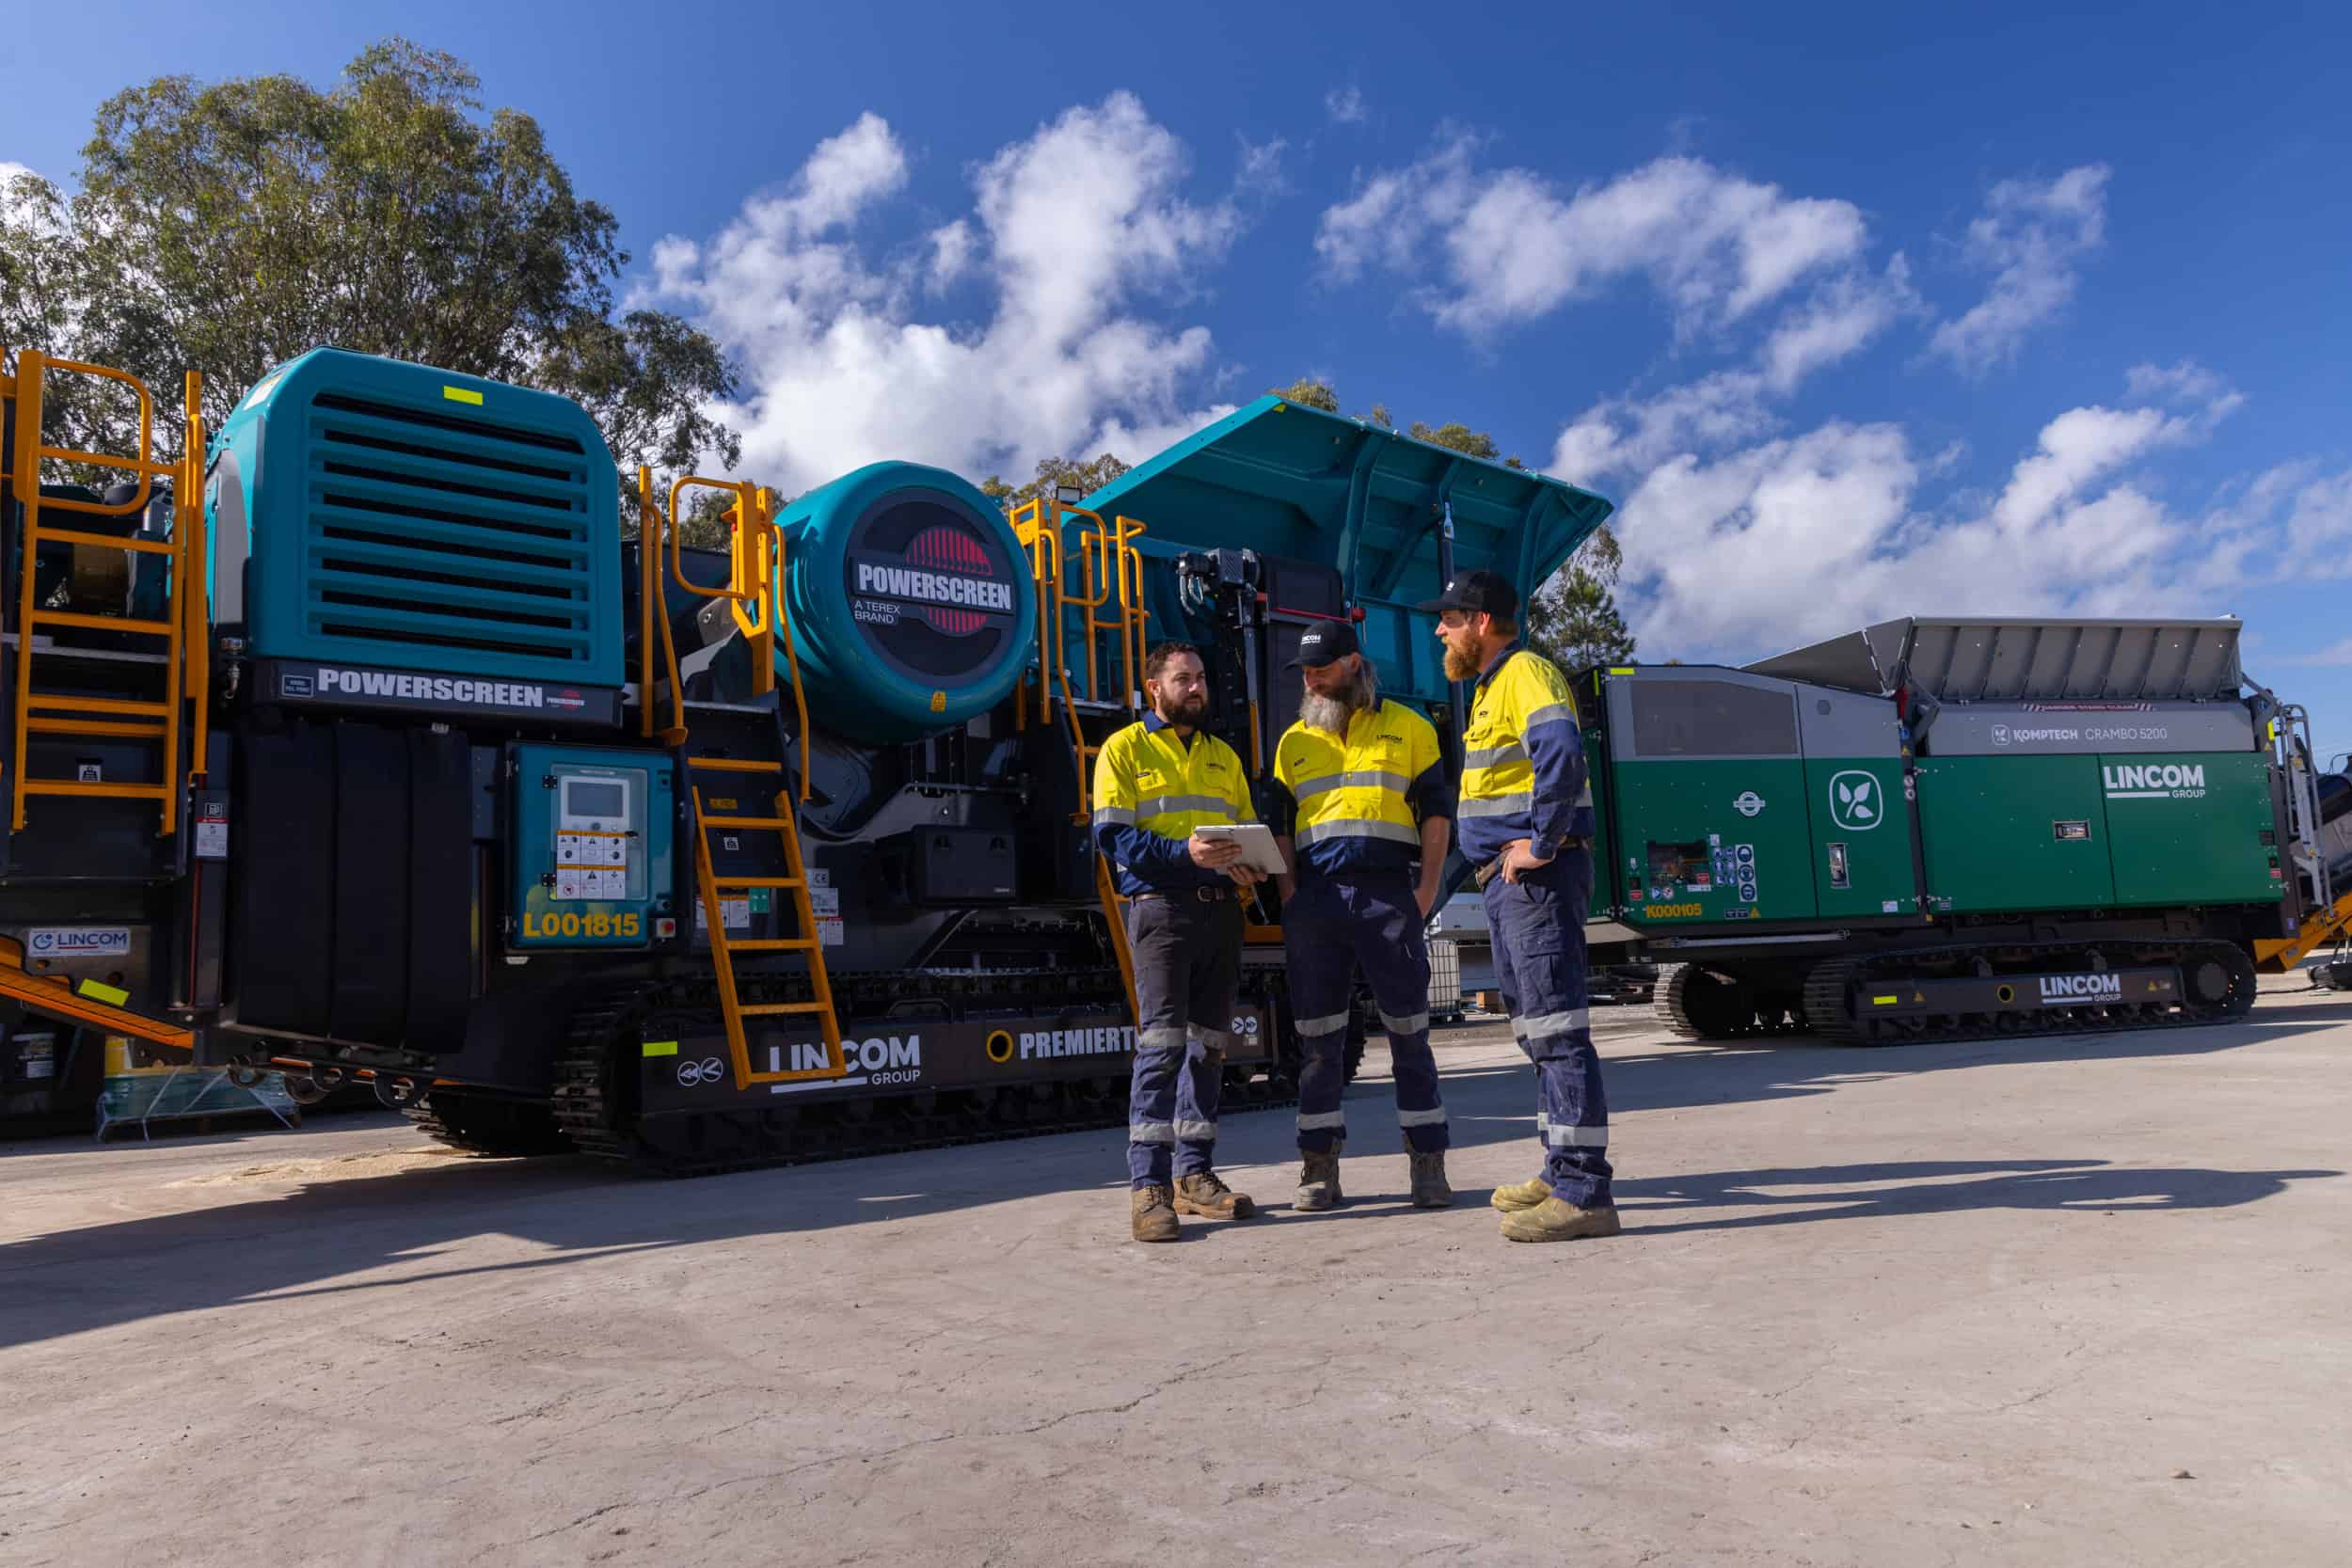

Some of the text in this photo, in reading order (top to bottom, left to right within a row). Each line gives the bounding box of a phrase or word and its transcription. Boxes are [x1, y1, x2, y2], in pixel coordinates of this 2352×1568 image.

[858, 563, 1011, 610] POWERSCREEN
[854, 599, 900, 615] A TEREX
[854, 610, 894, 624] BRAND
[318, 668, 543, 707] POWERSCREEN
[2013, 727, 2168, 741] KOMPTECH CRAMBO 5200
[2104, 765, 2205, 789] LINCOM
[2171, 789, 2206, 799] GROUP
[57, 932, 127, 945] LINCOM
[2040, 973, 2121, 996] LINCOM
[2094, 993, 2122, 1002] GROUP
[871, 1069, 921, 1085] GROUP
